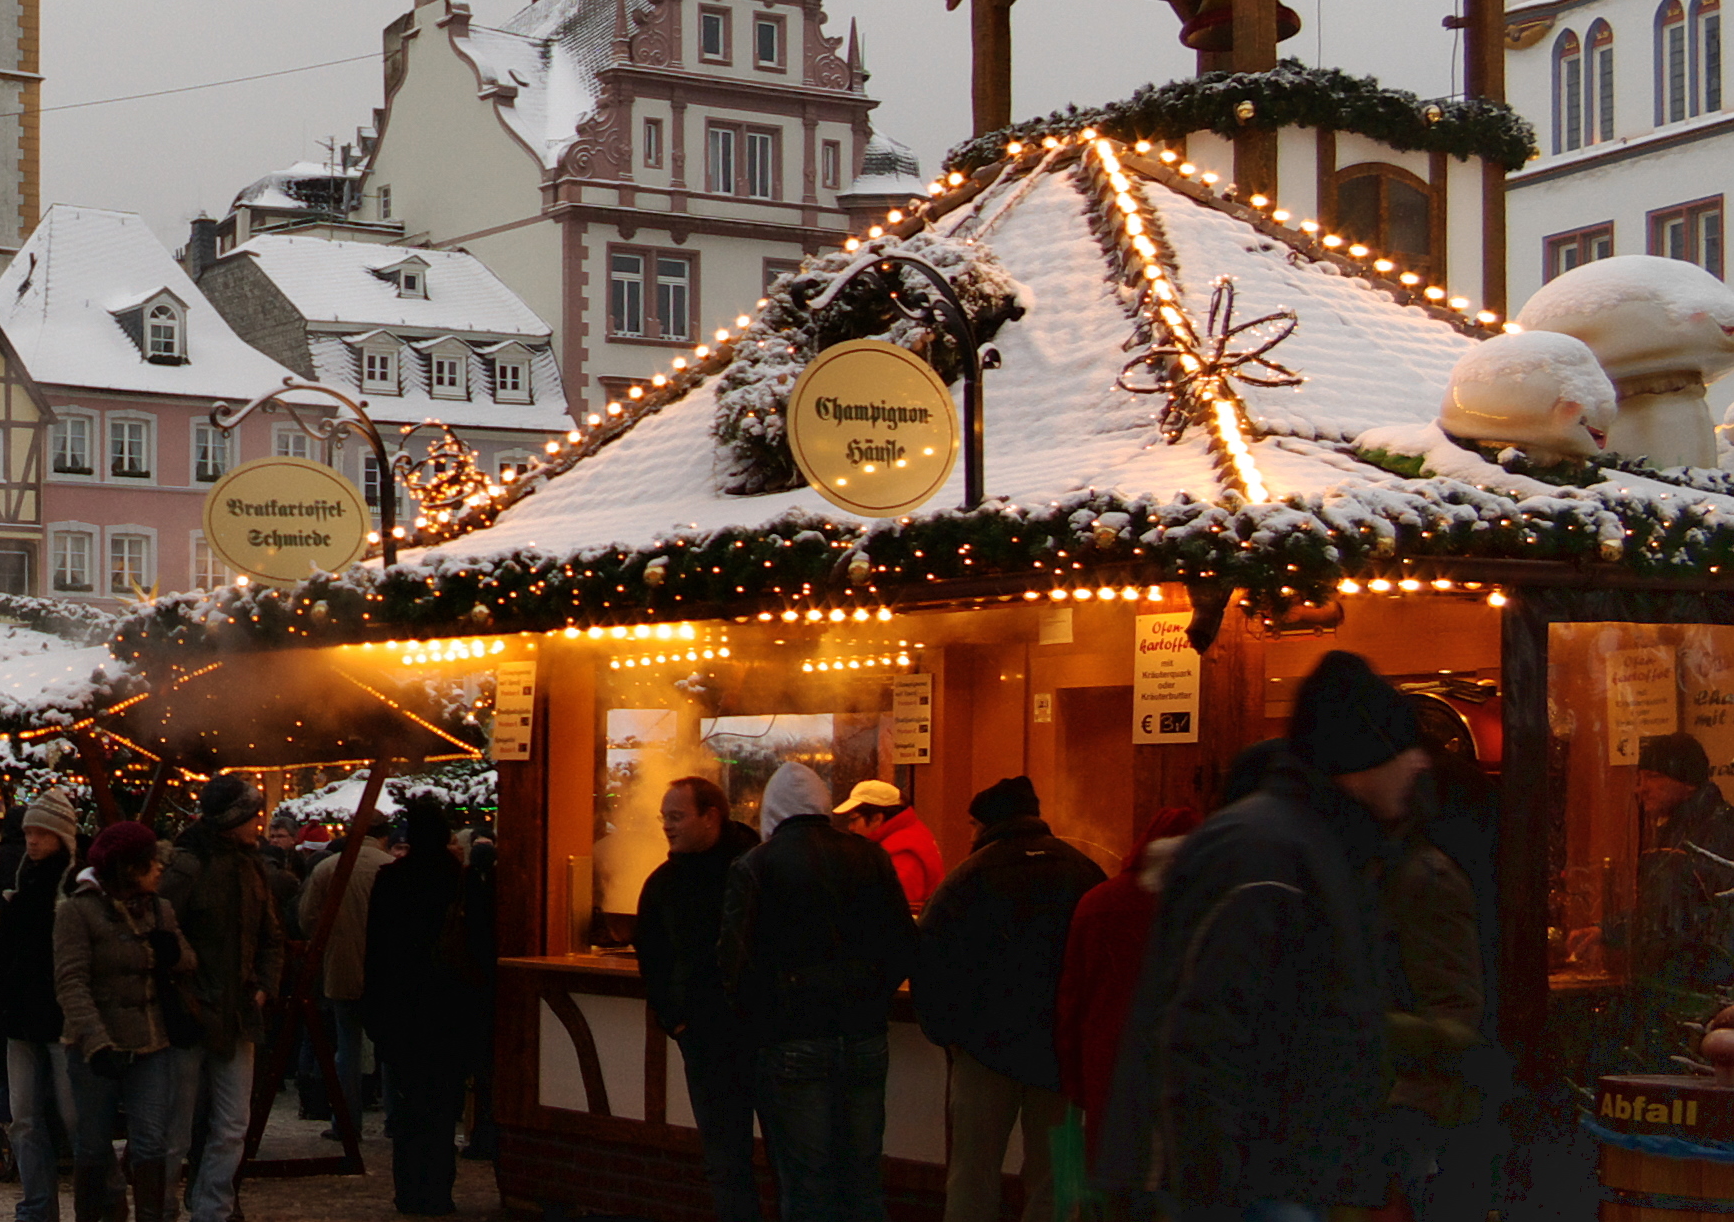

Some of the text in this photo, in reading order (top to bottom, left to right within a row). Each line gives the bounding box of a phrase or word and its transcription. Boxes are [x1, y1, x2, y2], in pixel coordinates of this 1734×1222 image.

[815, 396, 934, 430] Champignon-
[247, 529, 332, 551] Schmiede
[1139, 637, 1193, 654] kartoffe
[1157, 681, 1176, 690] oder
[1600, 1092, 1698, 1126] Abfall
